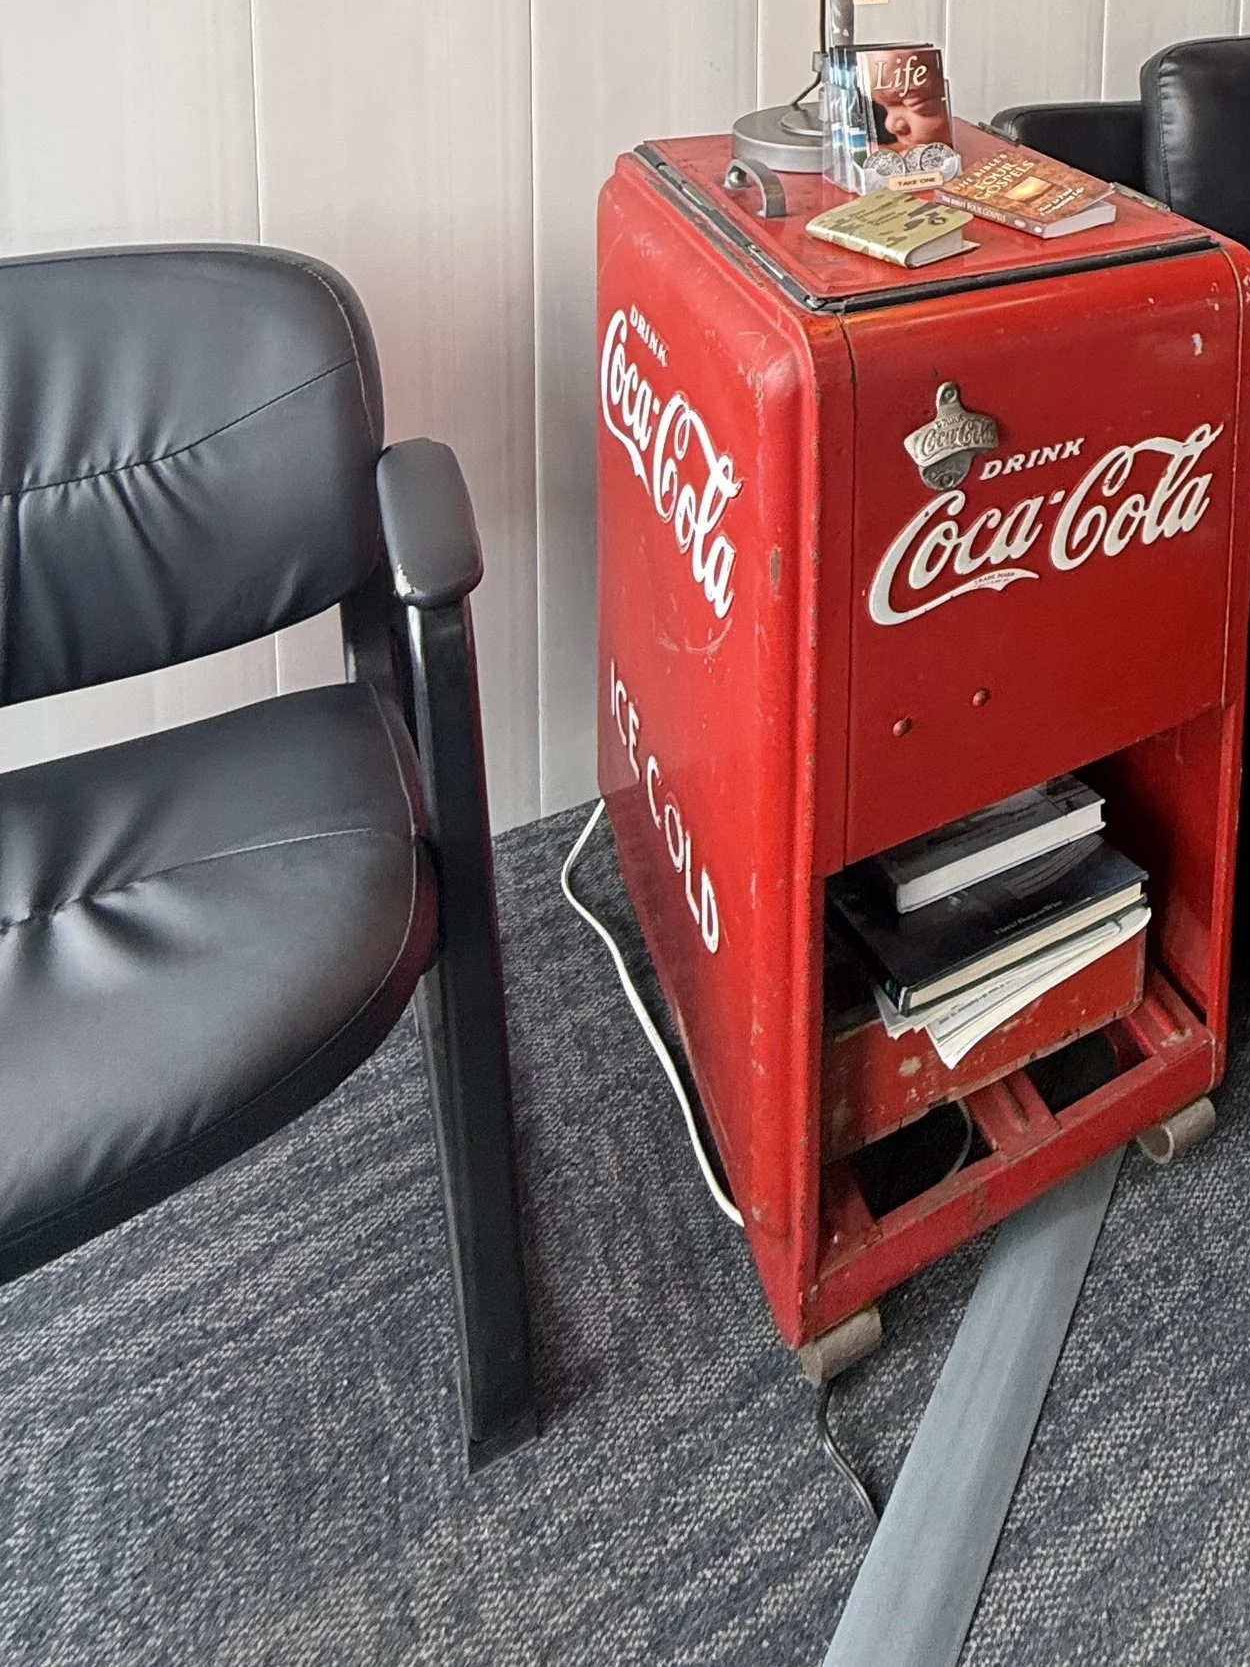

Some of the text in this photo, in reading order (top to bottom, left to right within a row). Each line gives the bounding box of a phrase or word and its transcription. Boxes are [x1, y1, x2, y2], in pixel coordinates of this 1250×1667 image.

[874, 55, 928, 97] Life
[973, 162, 1018, 191] FOUR
[974, 160, 1035, 201] GOSPELS
[629, 304, 668, 368] DRINK
[979, 437, 1085, 481] DRINK
[868, 423, 1224, 626] Coca-Cola
[647, 755, 720, 954] COLD
